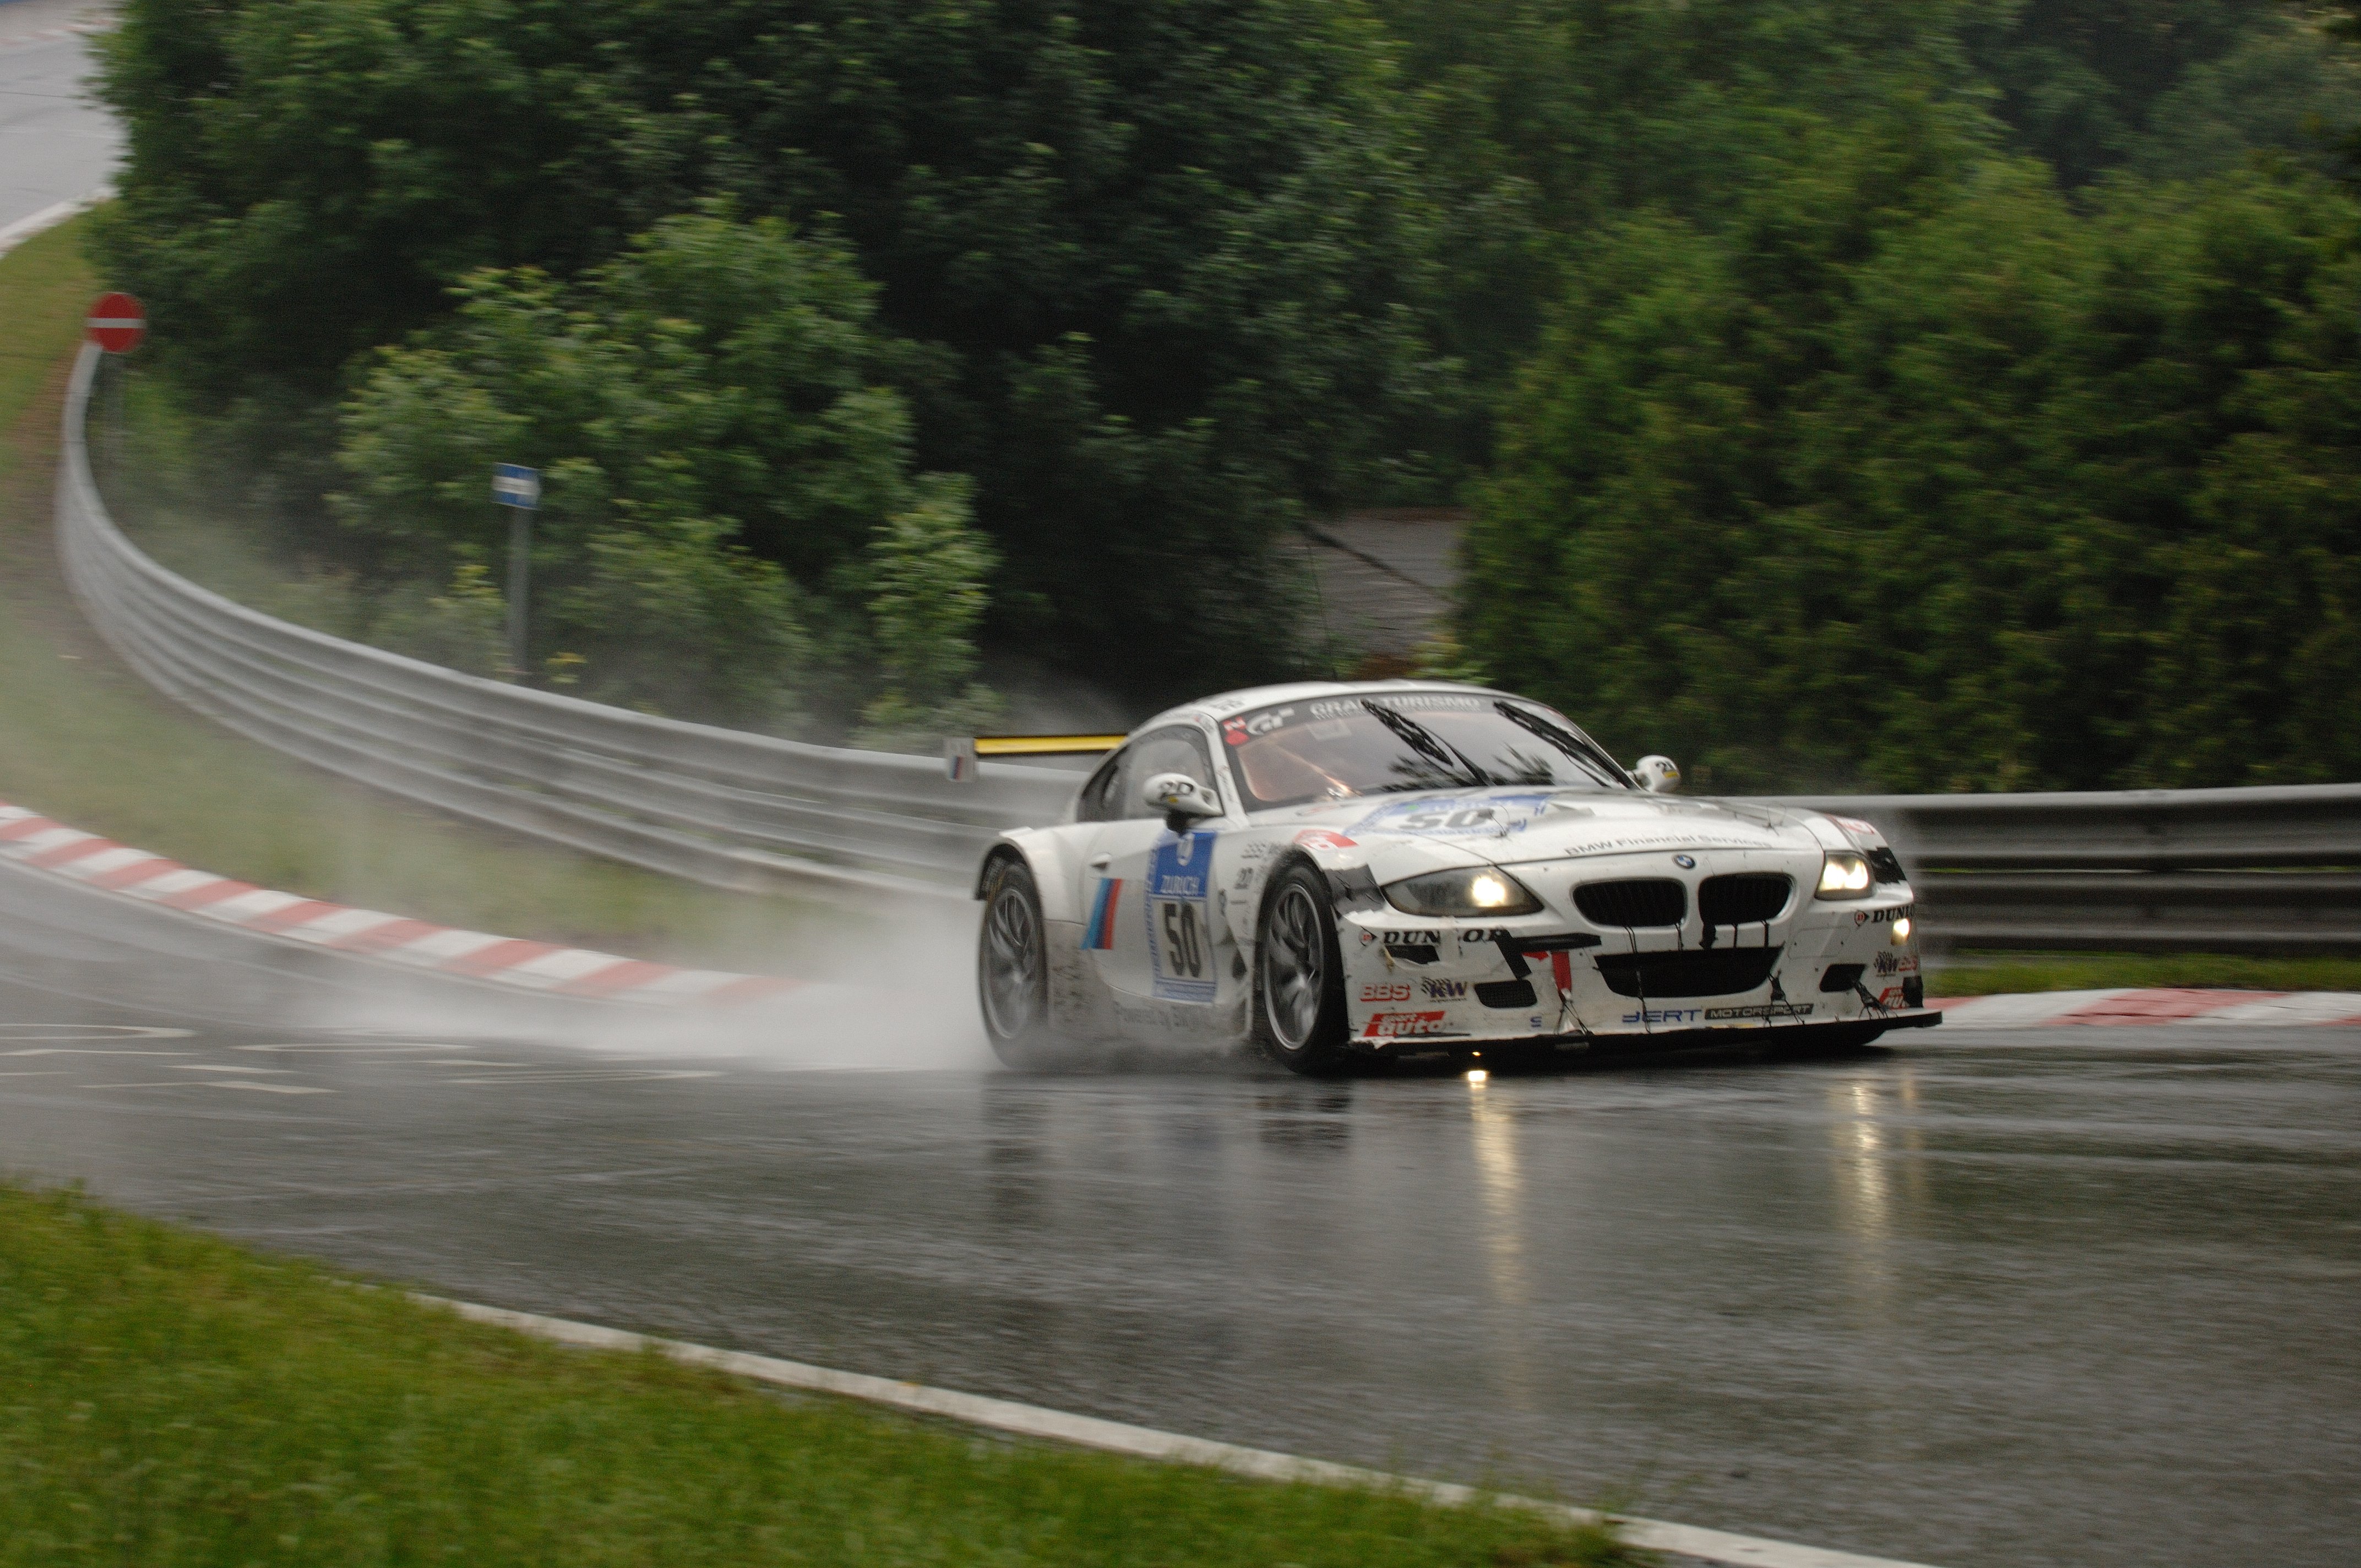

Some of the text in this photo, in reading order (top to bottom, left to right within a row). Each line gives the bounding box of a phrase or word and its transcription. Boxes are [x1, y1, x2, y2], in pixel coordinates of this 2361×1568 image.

[1379, 696, 1481, 711] TURISMO
[1399, 809, 1494, 829] 50
[1564, 834, 1772, 856] BMW Financial Services
[1871, 905, 1914, 924] DUNL
[1165, 903, 1202, 978] 50
[1383, 929, 1504, 944] DUNOP
[1359, 983, 1411, 1002] BBS
[1430, 981, 1468, 998] KW
[1710, 1004, 1811, 1018] MOTORSPORT
[1377, 1018, 1447, 1037] auto
